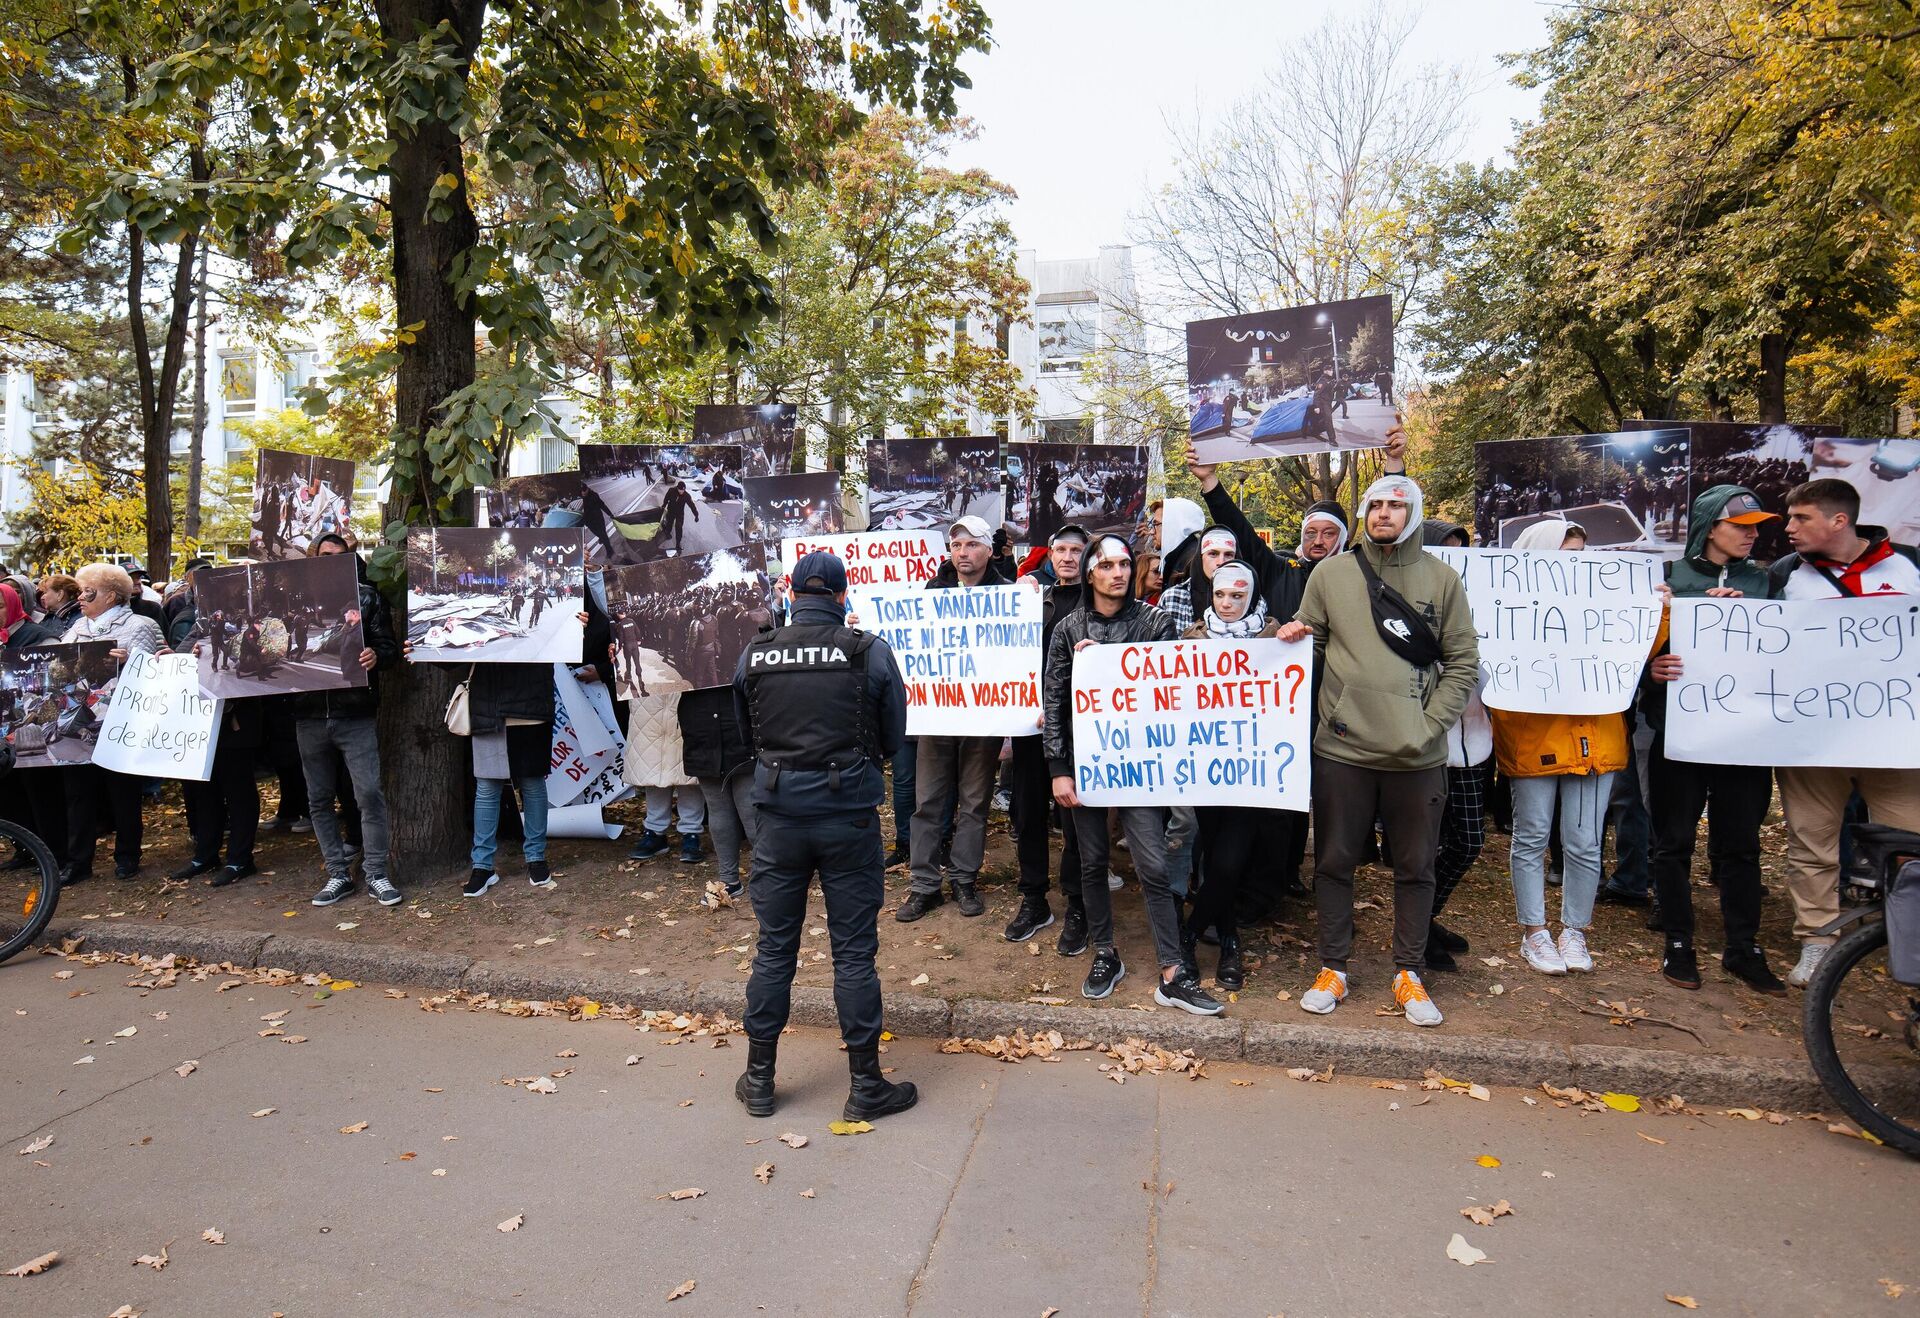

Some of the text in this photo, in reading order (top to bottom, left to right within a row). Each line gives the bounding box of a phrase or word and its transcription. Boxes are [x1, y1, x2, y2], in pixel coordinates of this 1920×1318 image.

[867, 539, 929, 559] CAGULA
[884, 564, 901, 583] AL
[871, 596, 924, 624] TOATE
[941, 625, 969, 649] LE-A
[975, 621, 1043, 648] PROVOCAT
[1391, 619, 1412, 637] NIKE
[1583, 606, 1660, 645] PESTE
[1693, 603, 1790, 654] PAS
[750, 646, 848, 667] POLIȚIA
[971, 671, 1040, 708] VOASTRĂ
[1075, 687, 1103, 714] DE
[1112, 687, 1138, 713] CE
[1153, 685, 1182, 712] NE
[107, 721, 137, 748] de
[1145, 723, 1176, 748] NU
[564, 756, 590, 783] DE
